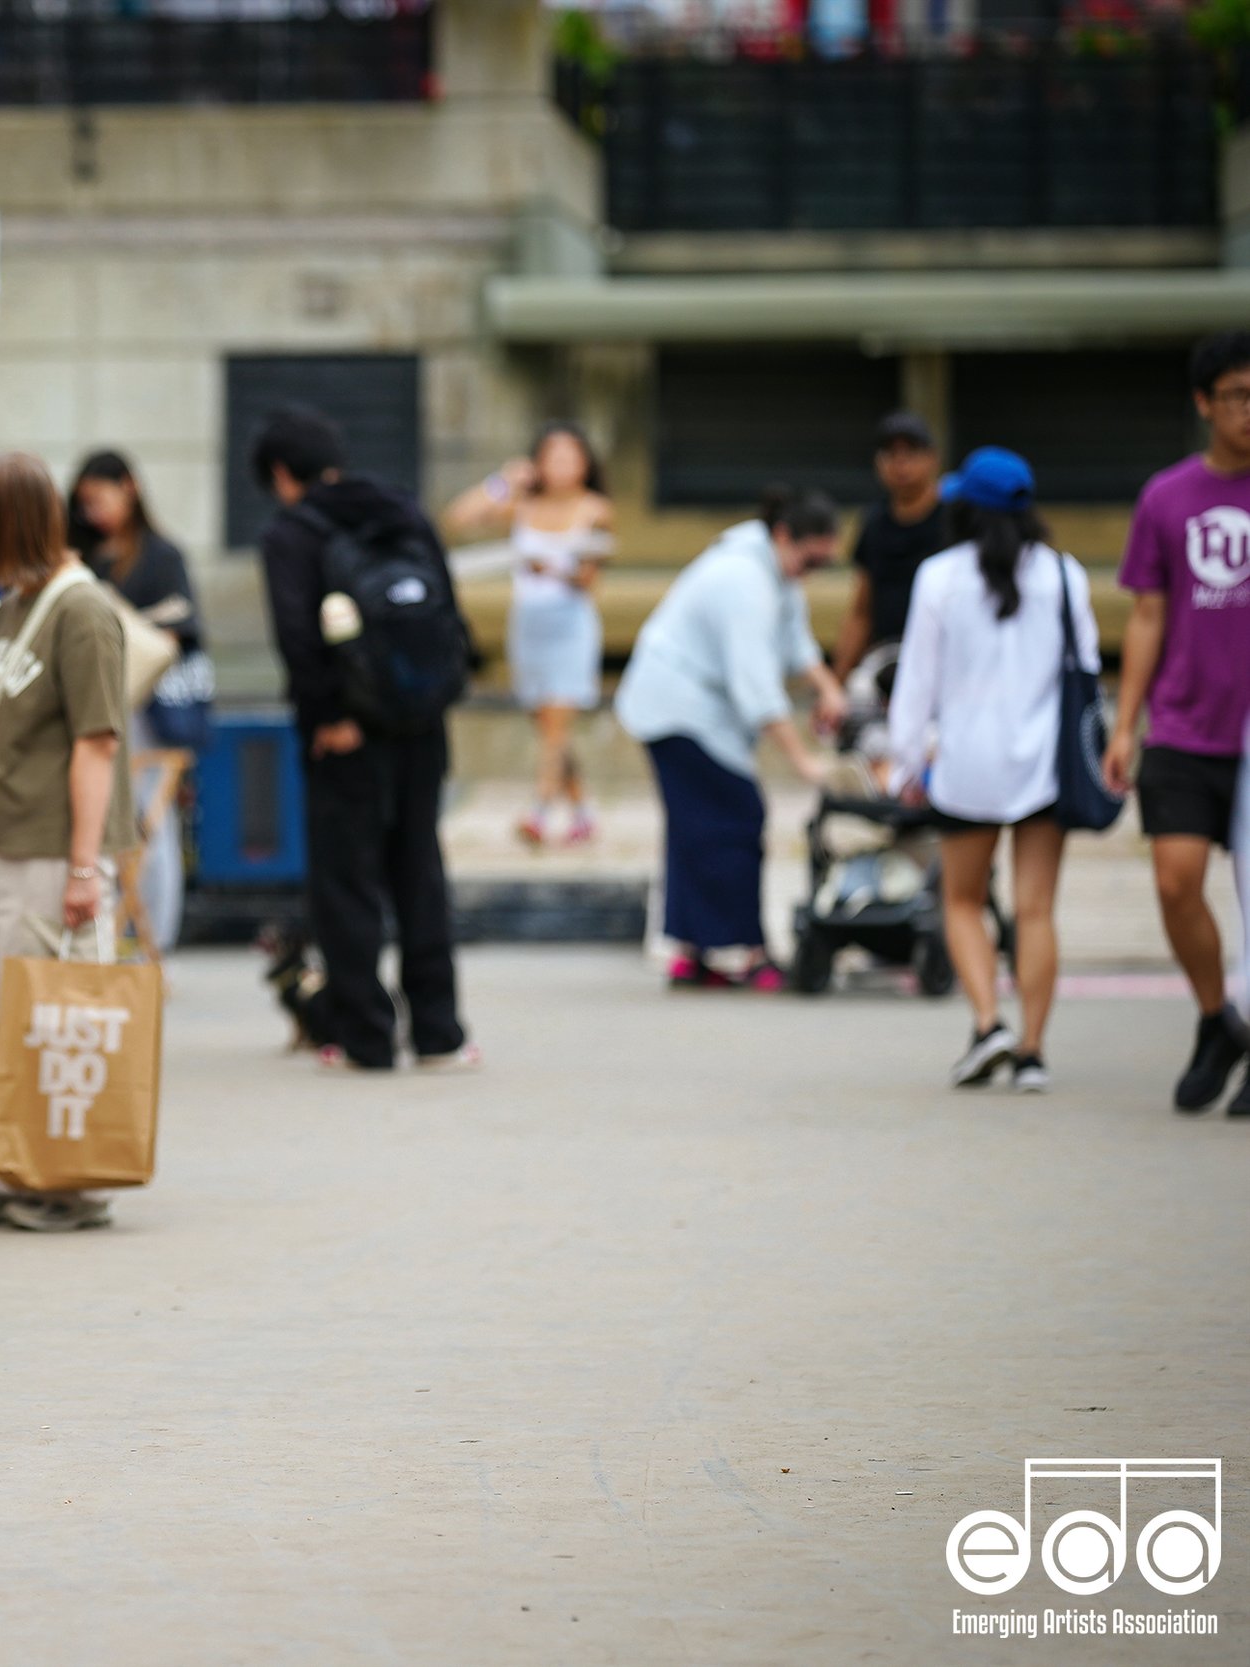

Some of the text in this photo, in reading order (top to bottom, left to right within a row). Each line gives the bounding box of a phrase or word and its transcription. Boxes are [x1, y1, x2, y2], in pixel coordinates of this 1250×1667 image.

[22, 1003, 131, 1053] JUST
[38, 1049, 108, 1094] DO
[47, 1095, 95, 1141] IT
